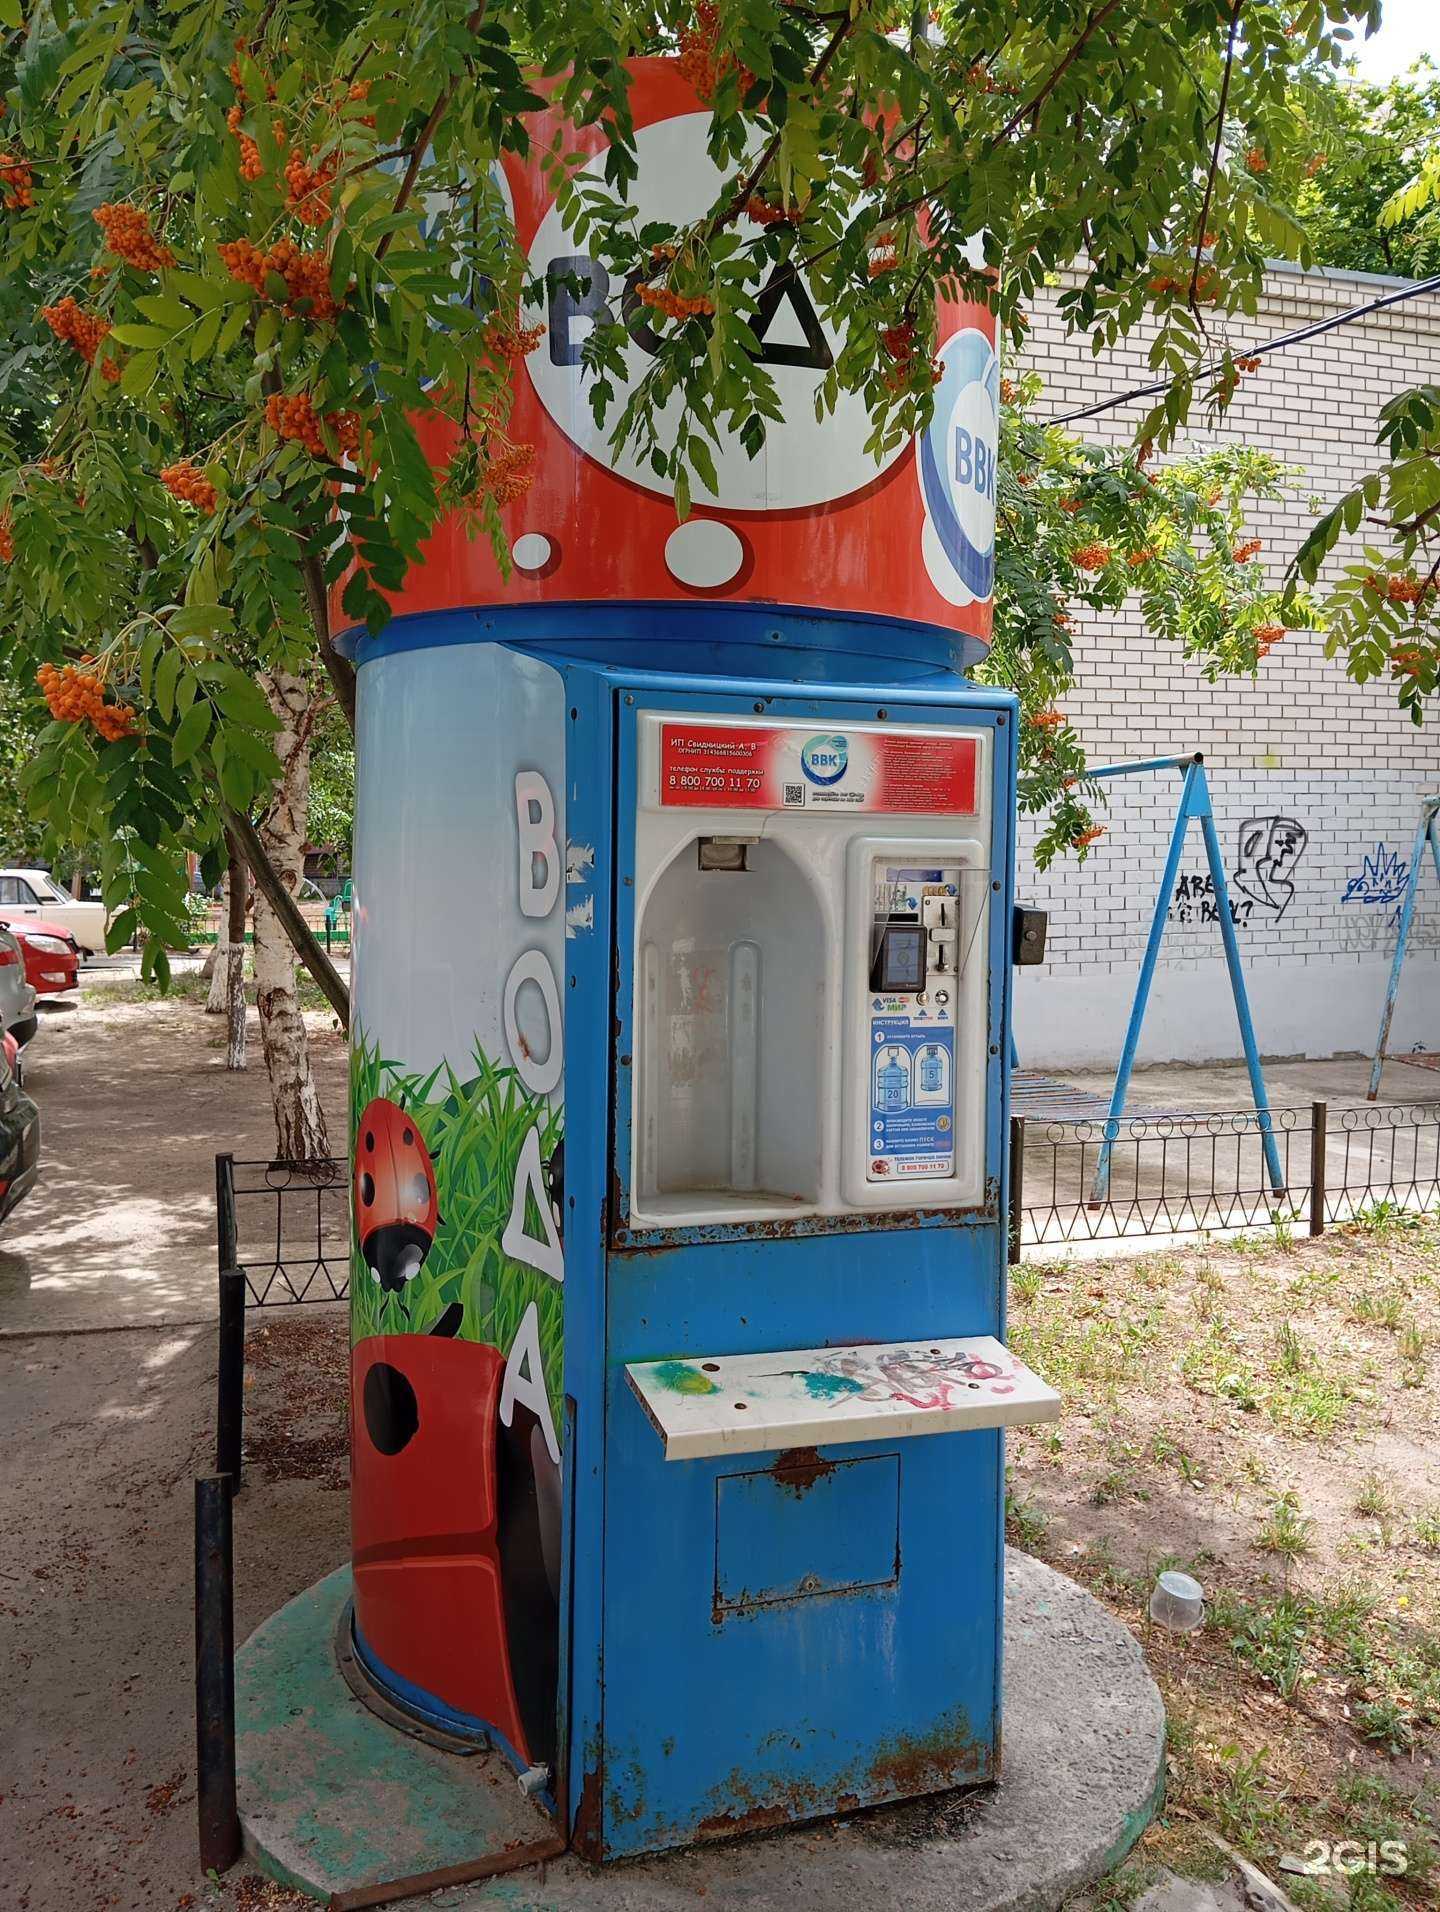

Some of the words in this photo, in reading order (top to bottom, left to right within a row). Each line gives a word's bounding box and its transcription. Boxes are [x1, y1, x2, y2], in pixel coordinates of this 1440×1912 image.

[671, 738, 684, 746] ИП
[811, 754, 838, 767] ВВК
[669, 765, 698, 775] телефон
[699, 766, 726, 775] службы
[727, 768, 764, 777] поддержки
[669, 775, 676, 785] 8
[680, 775, 701, 786] 800
[705, 777, 725, 787] 700
[729, 778, 741, 787] 11
[746, 778, 760, 788] 70
[929, 1071, 935, 1079] 5
[888, 1090, 899, 1099] 20
[501, 771, 564, 1464] ВОДА
